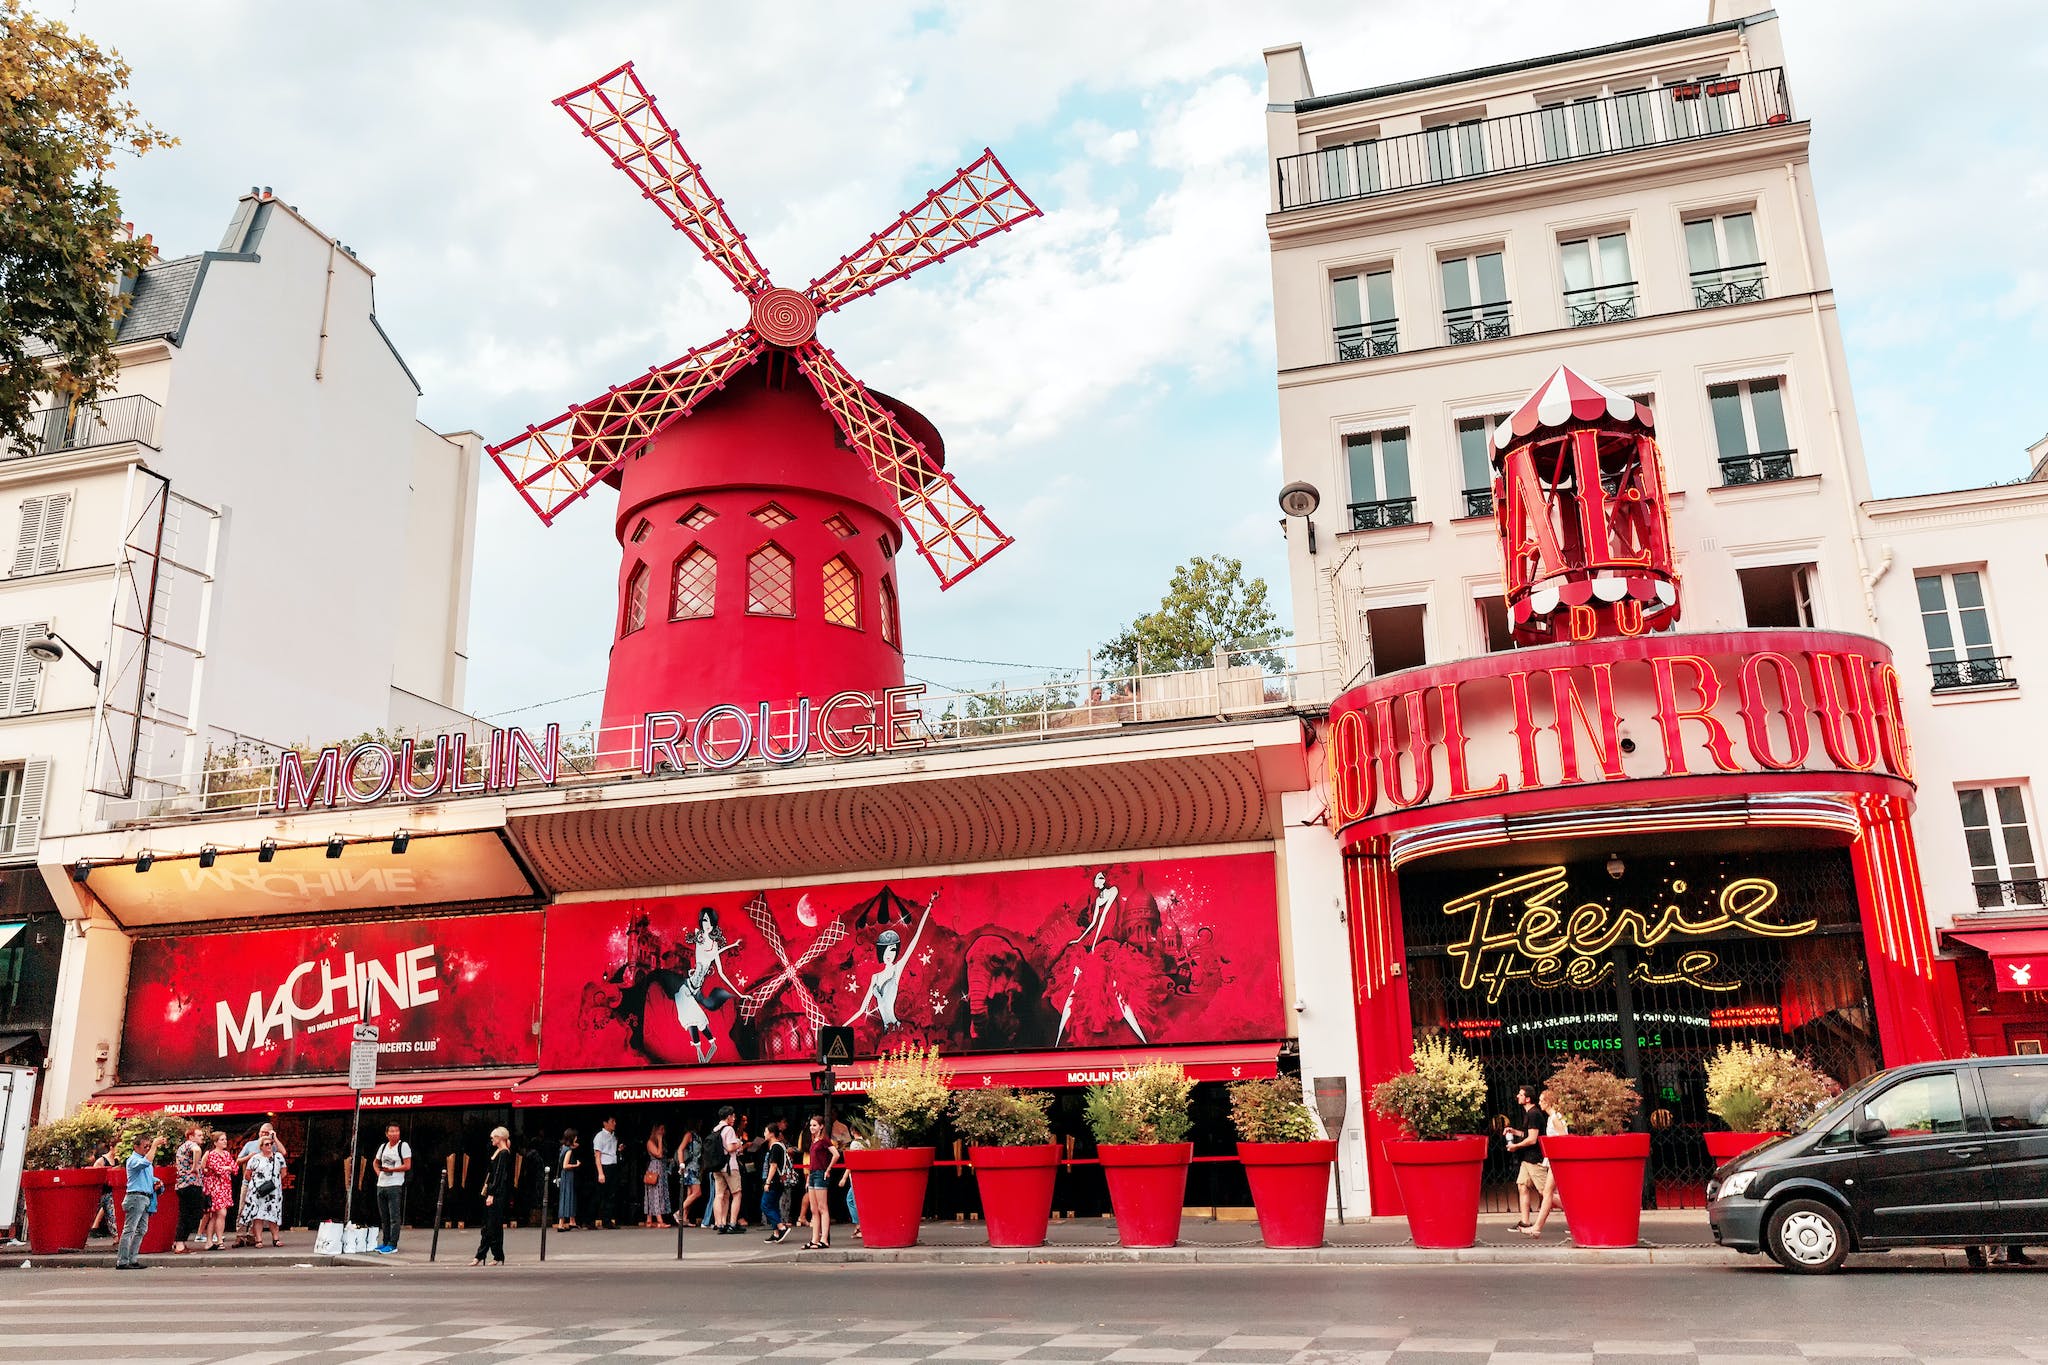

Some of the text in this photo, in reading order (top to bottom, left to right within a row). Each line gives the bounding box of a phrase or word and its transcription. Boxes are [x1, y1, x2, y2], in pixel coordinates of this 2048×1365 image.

[1503, 428, 1652, 597] AL
[1570, 600, 1644, 641] DU
[276, 683, 927, 811] MOULIN ROUGE
[1327, 661, 1629, 838] OULIN
[1443, 865, 1818, 990] Féerie
[215, 943, 440, 1059] MACHINE
[307, 1013, 359, 1034] DU MOULIN ROUGE
[1662, 1013, 1676, 1022] DU
[376, 1040, 437, 1053] NCERTS CLUB
[1546, 1039, 1567, 1049] LES
[1067, 1071, 1110, 1083] MOULIN
[834, 1080, 872, 1091] MOULIN
[360, 1094, 424, 1106] MOULIN ROUGE
[613, 1087, 686, 1100] MOULIN ROUGE
[164, 1103, 224, 1113] MOULIN ROUGE
